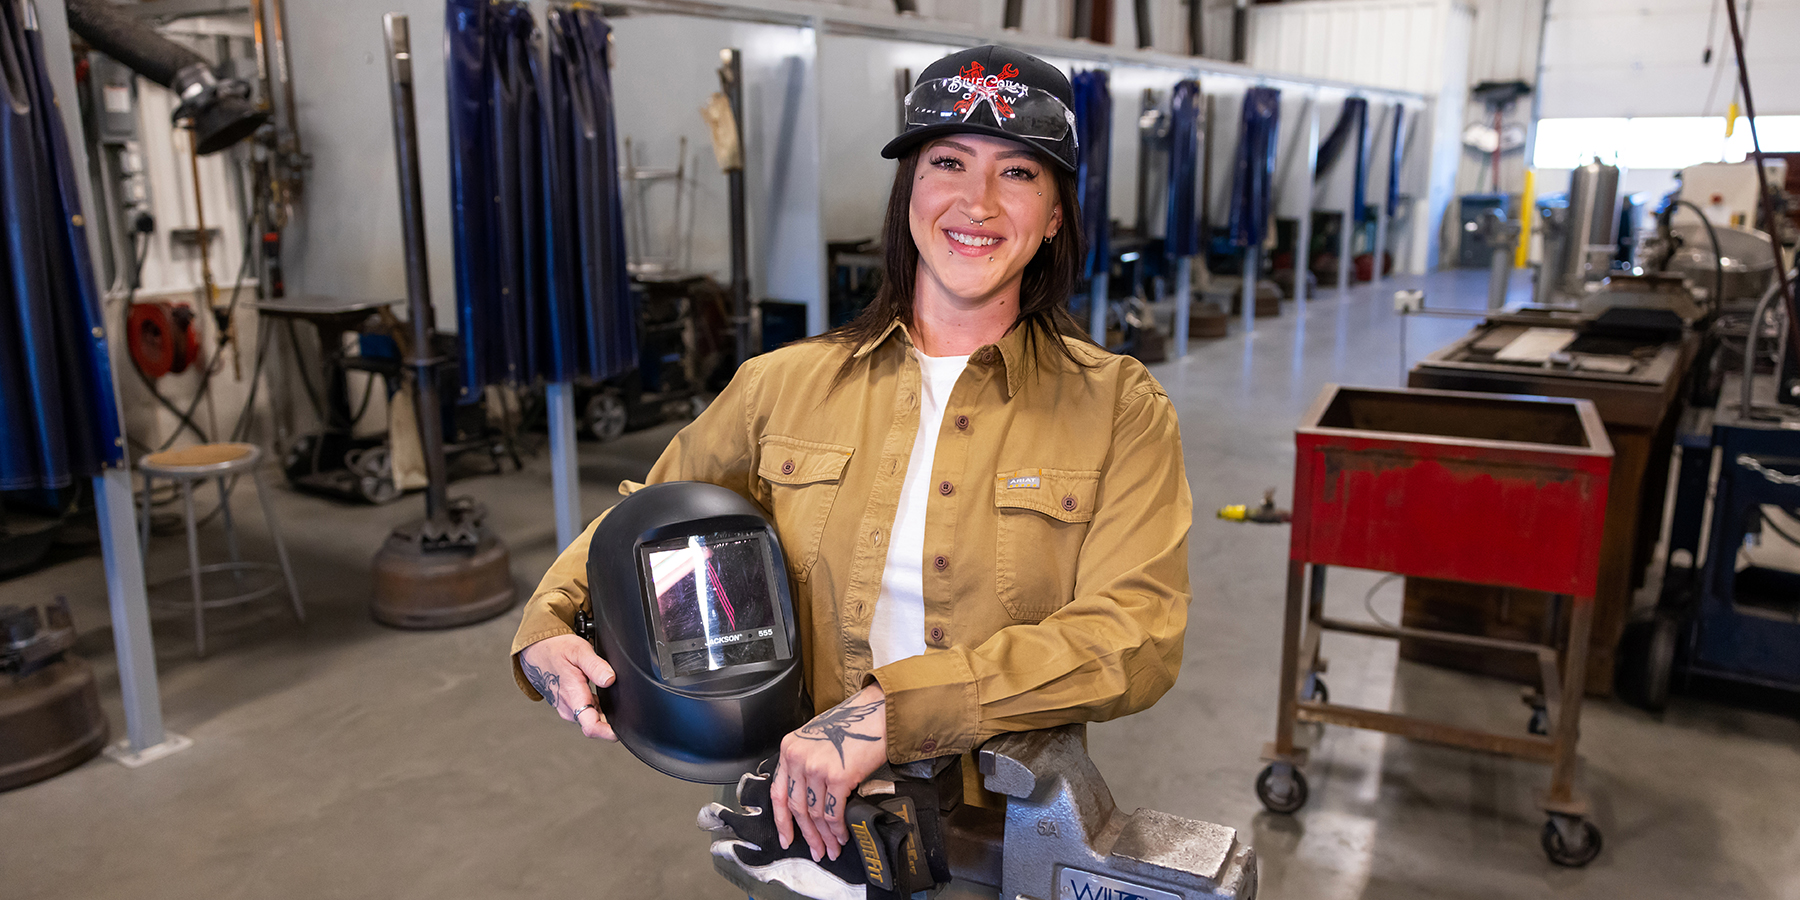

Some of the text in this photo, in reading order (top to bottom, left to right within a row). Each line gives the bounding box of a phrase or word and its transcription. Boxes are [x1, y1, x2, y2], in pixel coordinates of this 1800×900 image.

[963, 92, 1017, 105] CW
[758, 628, 774, 637] 555
[1037, 816, 1060, 839] 5A
